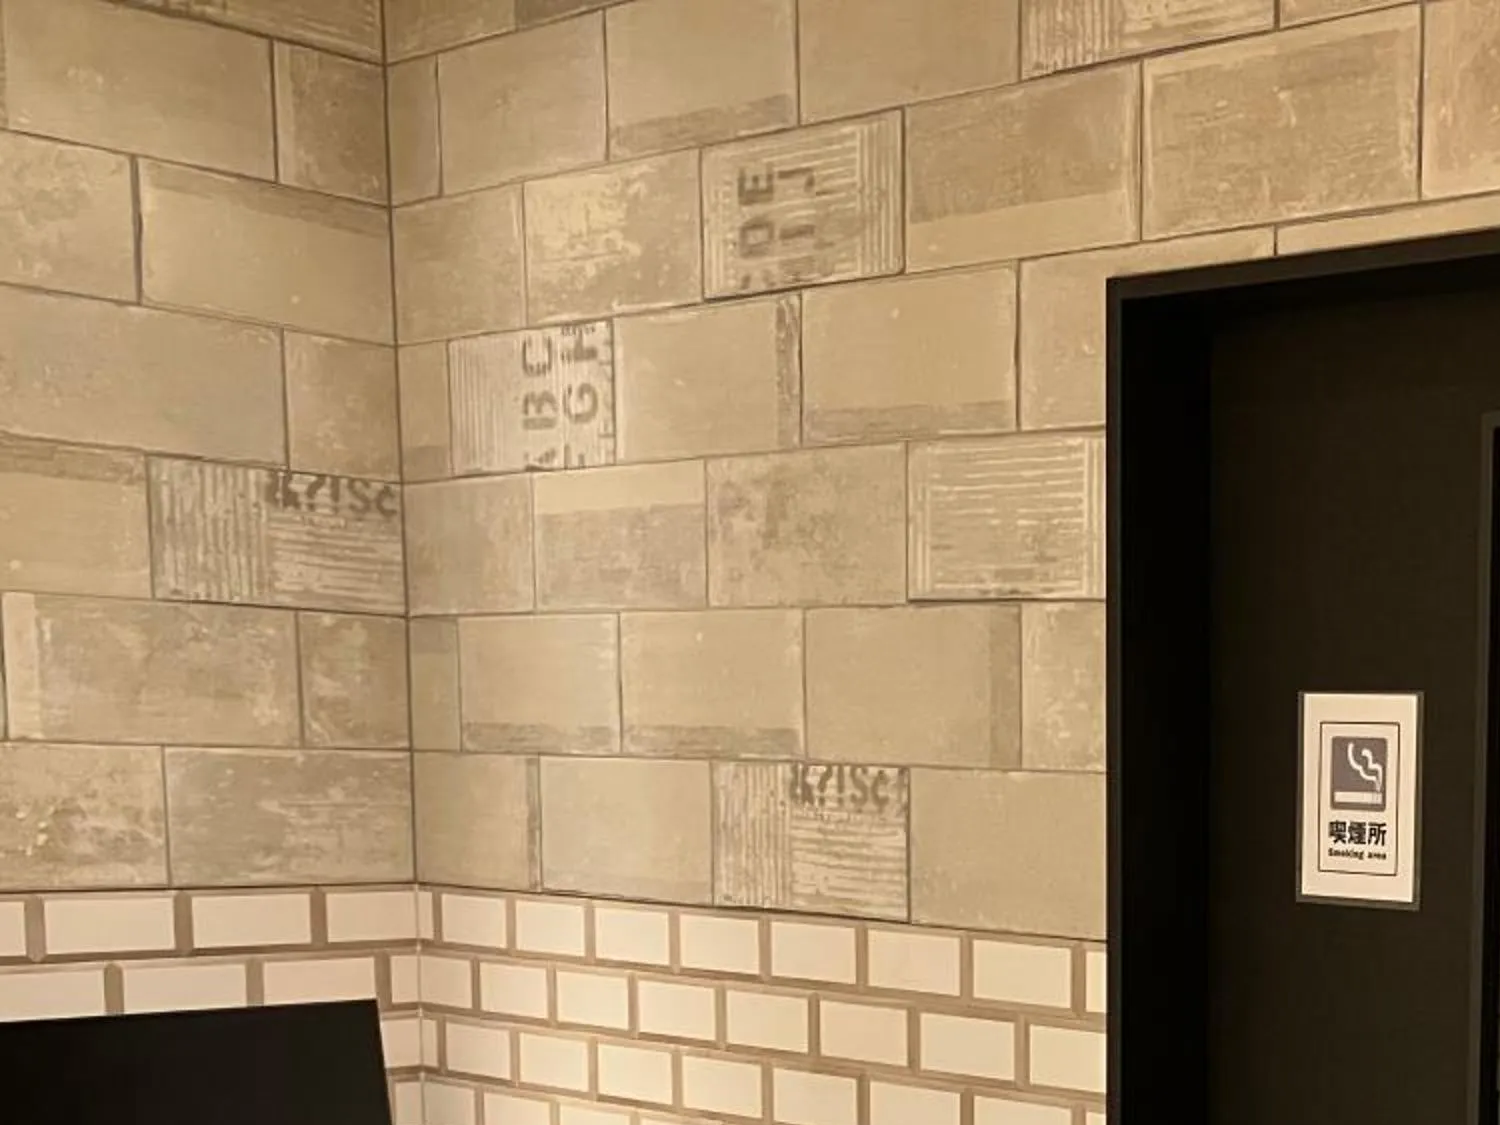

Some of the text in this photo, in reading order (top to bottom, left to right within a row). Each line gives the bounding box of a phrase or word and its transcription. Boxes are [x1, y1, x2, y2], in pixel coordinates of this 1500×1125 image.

[1328, 820, 1387, 846] 喫煙所
[1328, 847, 1387, 860] Smoking area
